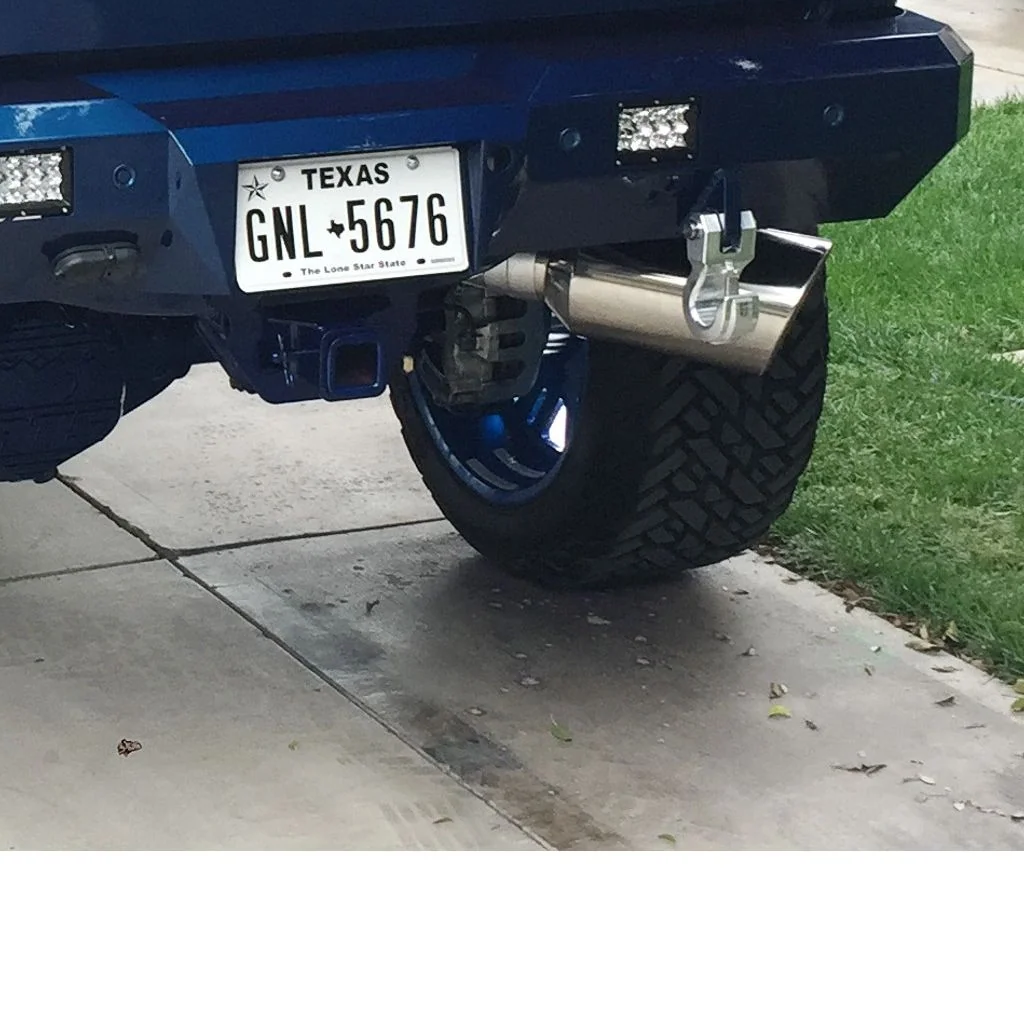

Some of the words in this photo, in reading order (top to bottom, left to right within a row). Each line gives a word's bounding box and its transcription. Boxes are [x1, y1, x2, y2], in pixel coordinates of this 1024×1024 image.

[301, 162, 390, 190] TEXAS
[245, 204, 323, 263] GNL
[346, 193, 449, 254] 5676
[300, 267, 321, 276] The
[324, 264, 349, 274] Lone
[353, 260, 375, 270] Star
[378, 259, 406, 268] State
